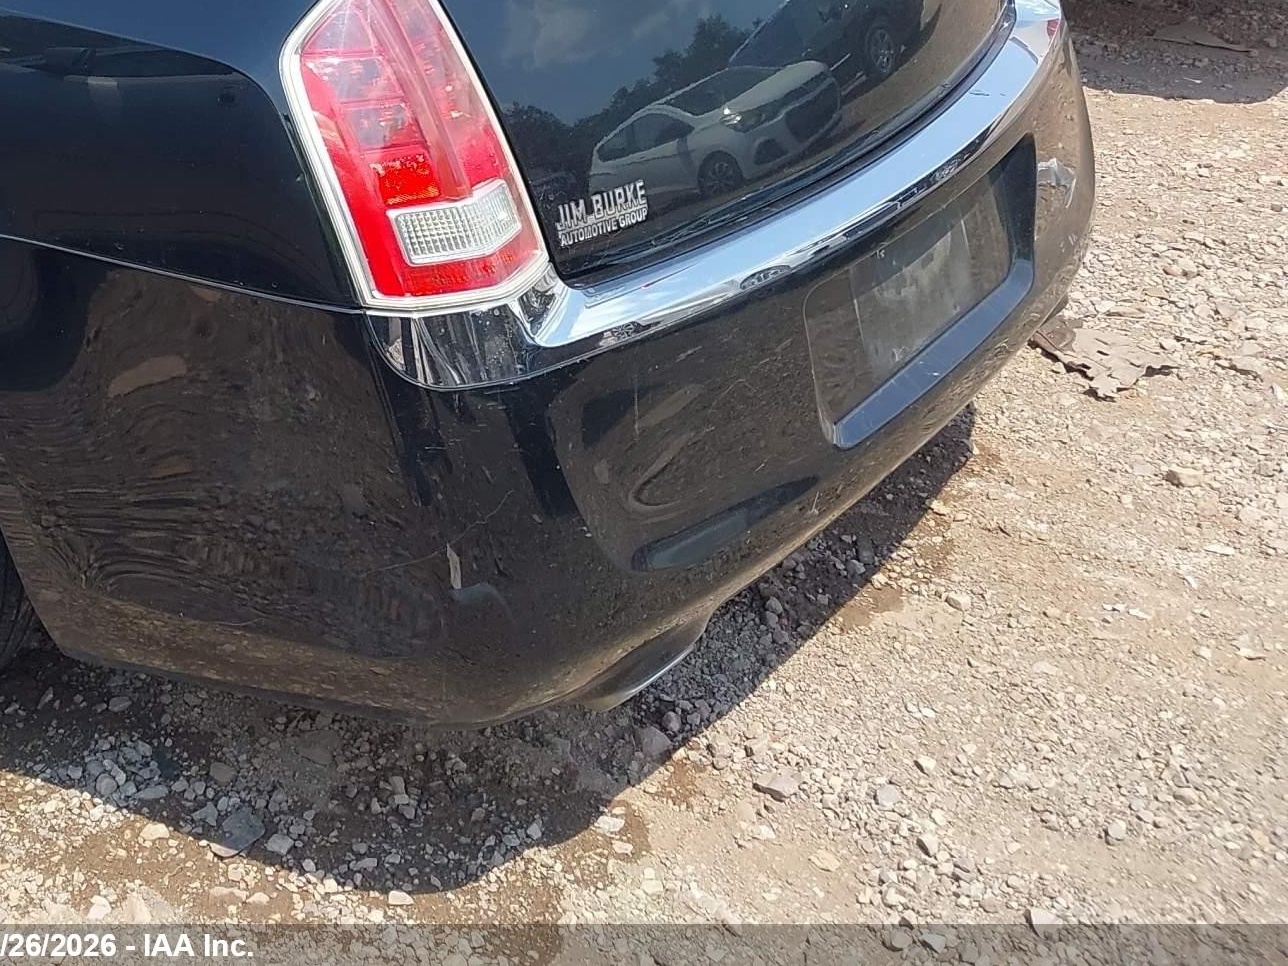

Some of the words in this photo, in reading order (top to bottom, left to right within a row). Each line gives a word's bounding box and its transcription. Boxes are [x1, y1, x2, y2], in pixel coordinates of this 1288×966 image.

[555, 198, 589, 231] JIM
[591, 179, 647, 218] BURKE
[558, 217, 619, 247] AUTOMOTIVE
[618, 208, 648, 228] GROUP
